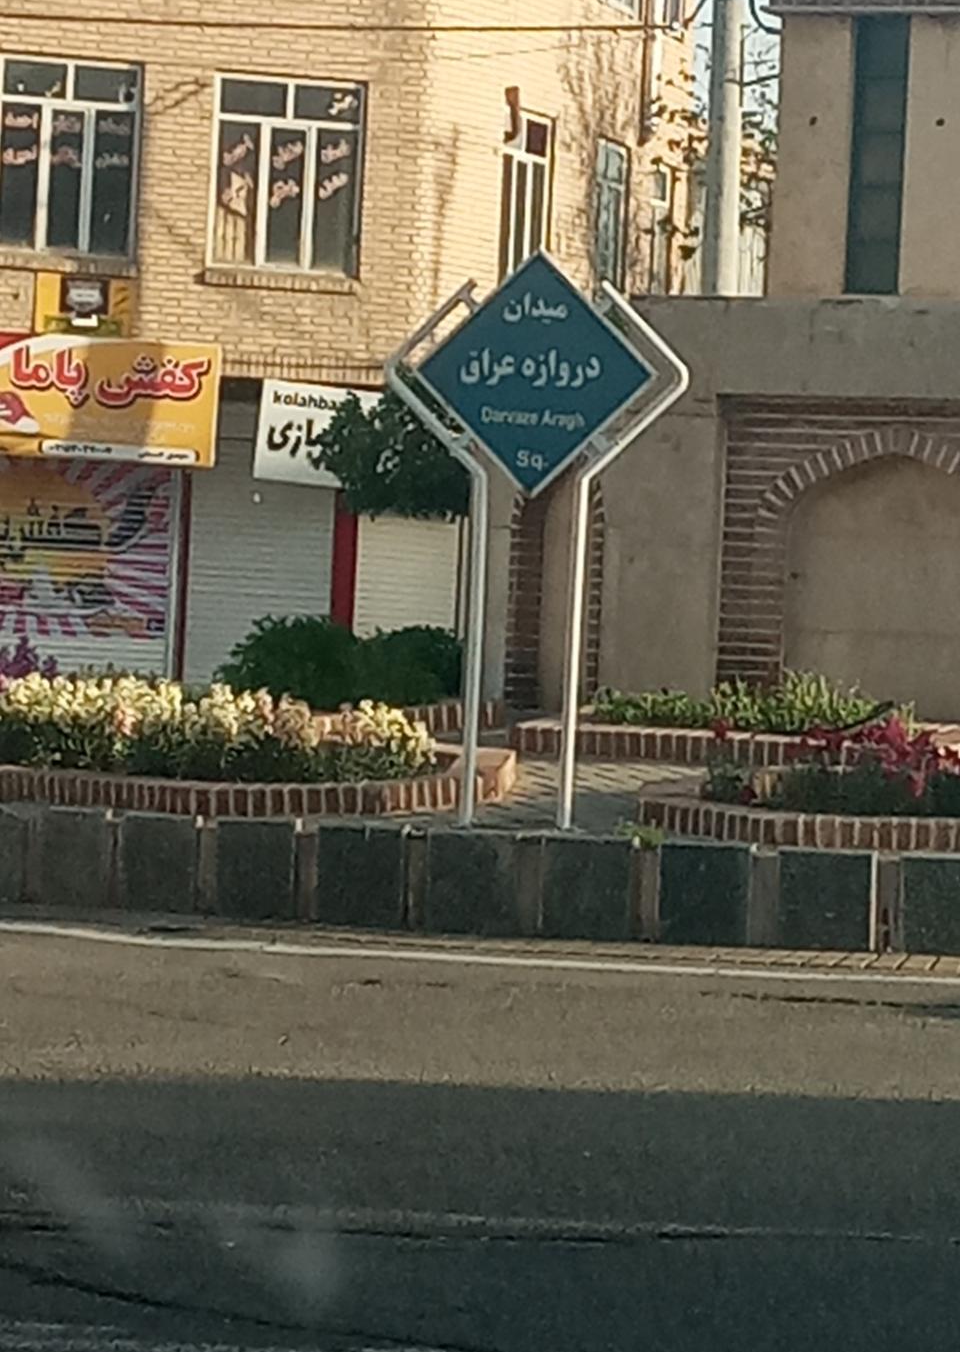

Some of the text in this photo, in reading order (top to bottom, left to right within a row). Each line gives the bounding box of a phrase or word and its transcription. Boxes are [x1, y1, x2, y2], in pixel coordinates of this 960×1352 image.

[503, 293, 568, 323] میدان
[10, 345, 211, 408] کفش پاما
[460, 349, 600, 387] دروازه عراق
[481, 406, 538, 425] Darvaze
[516, 450, 549, 471] Sq.
